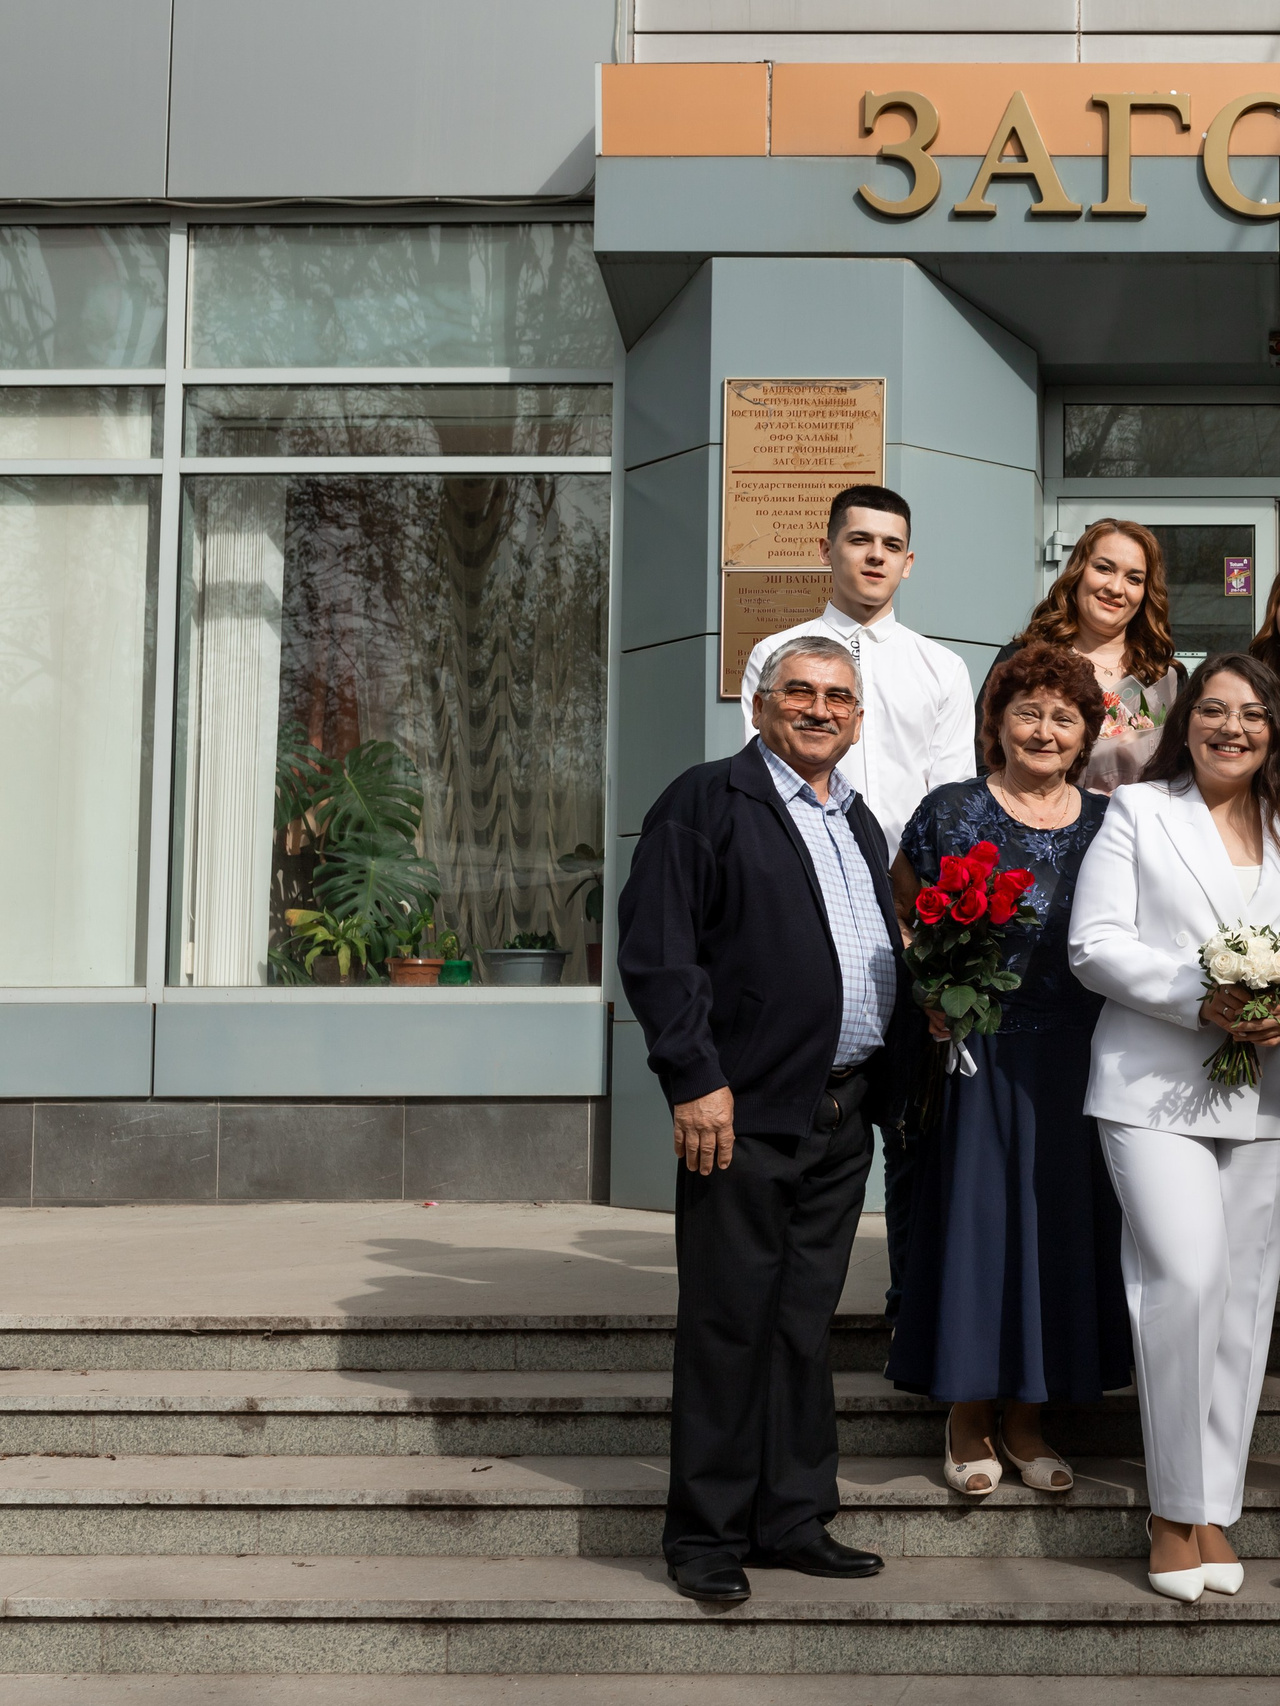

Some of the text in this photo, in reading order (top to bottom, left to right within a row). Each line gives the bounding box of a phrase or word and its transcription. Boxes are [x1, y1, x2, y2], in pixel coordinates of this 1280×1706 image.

[797, 421, 854, 430] КОМИТЕТЫ
[753, 445, 786, 454] СОВЕТ
[772, 457, 798, 466] ЗАГС
[735, 480, 826, 491] Государственный
[734, 494, 795, 505] Республики
[771, 509, 802, 517] делам
[772, 521, 804, 530] Отдел
[774, 534, 820, 543] Советско
[767, 549, 805, 559] района
[764, 574, 782, 584] ЭШ
[821, 587, 834, 595] 9.0
